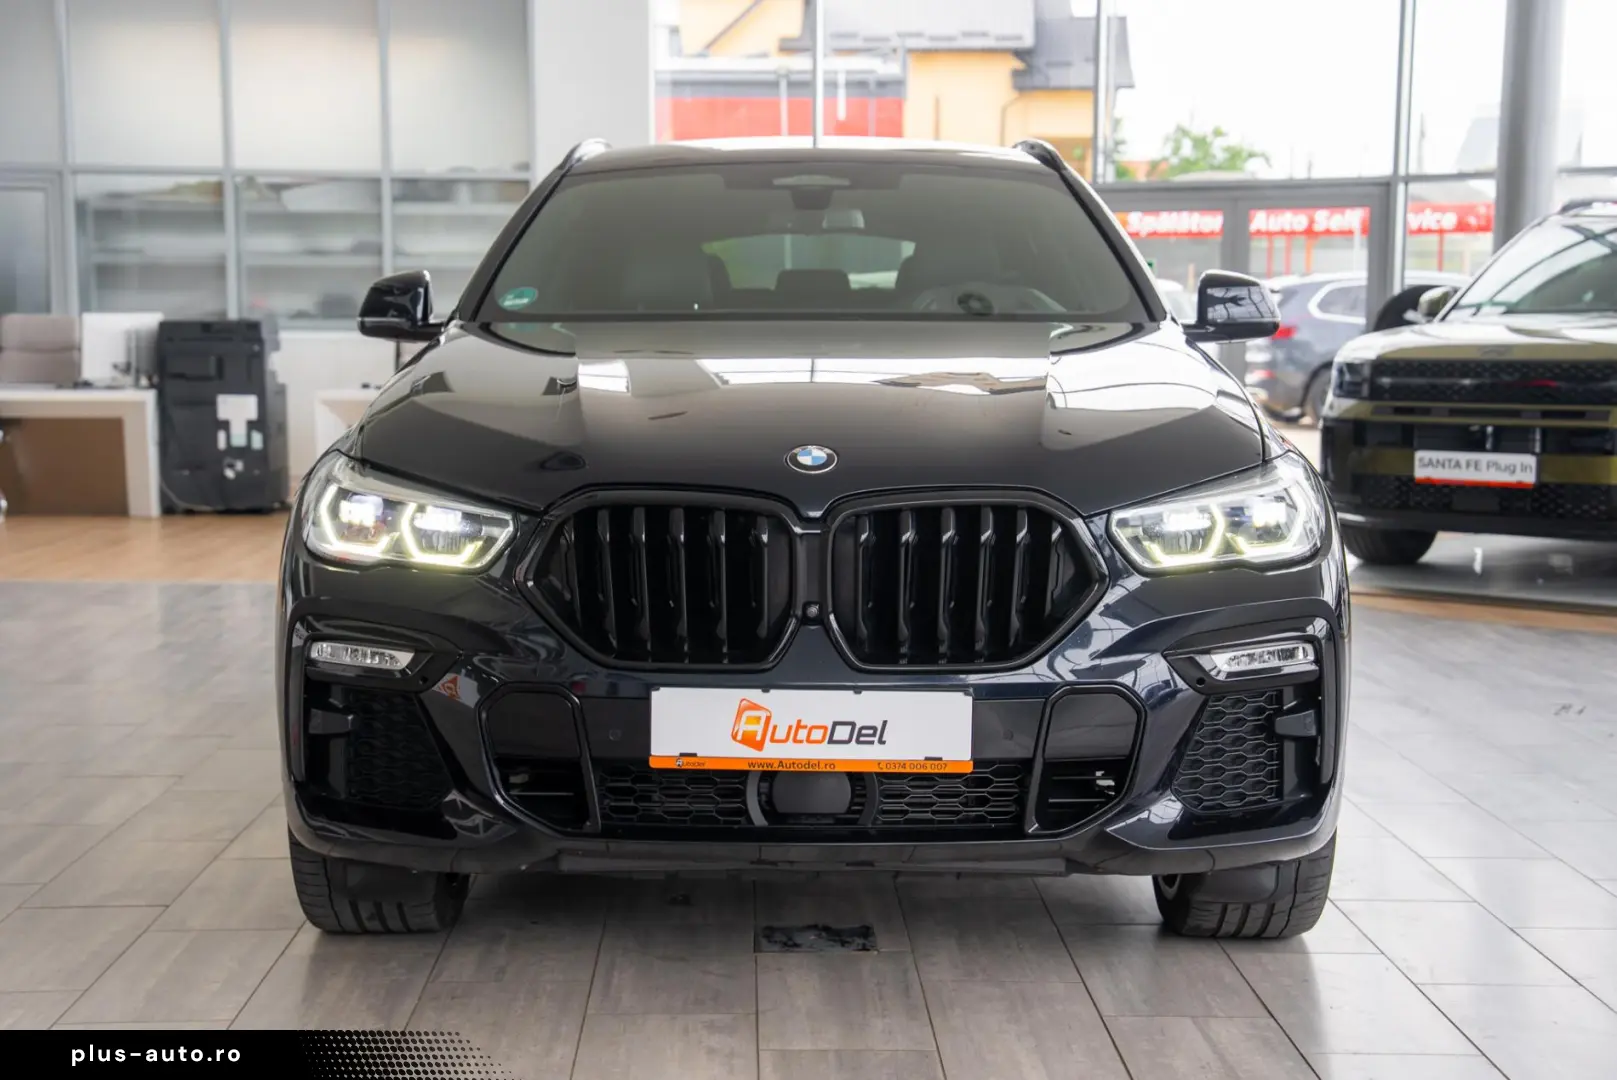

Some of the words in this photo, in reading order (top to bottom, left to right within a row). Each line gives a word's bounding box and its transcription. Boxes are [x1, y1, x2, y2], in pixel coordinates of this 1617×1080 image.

[1249, 209, 1308, 232] Auto
[1407, 207, 1457, 230] vice
[1418, 457, 1461, 471] SANTA
[1466, 459, 1482, 472] FE
[1486, 461, 1517, 476] Plug
[1520, 462, 1533, 473] In
[733, 701, 888, 749] AutoDel
[747, 760, 836, 770] www.Autodel.ro
[885, 762, 907, 771] 0374
[909, 763, 928, 771] 006
[930, 763, 947, 771] 007
